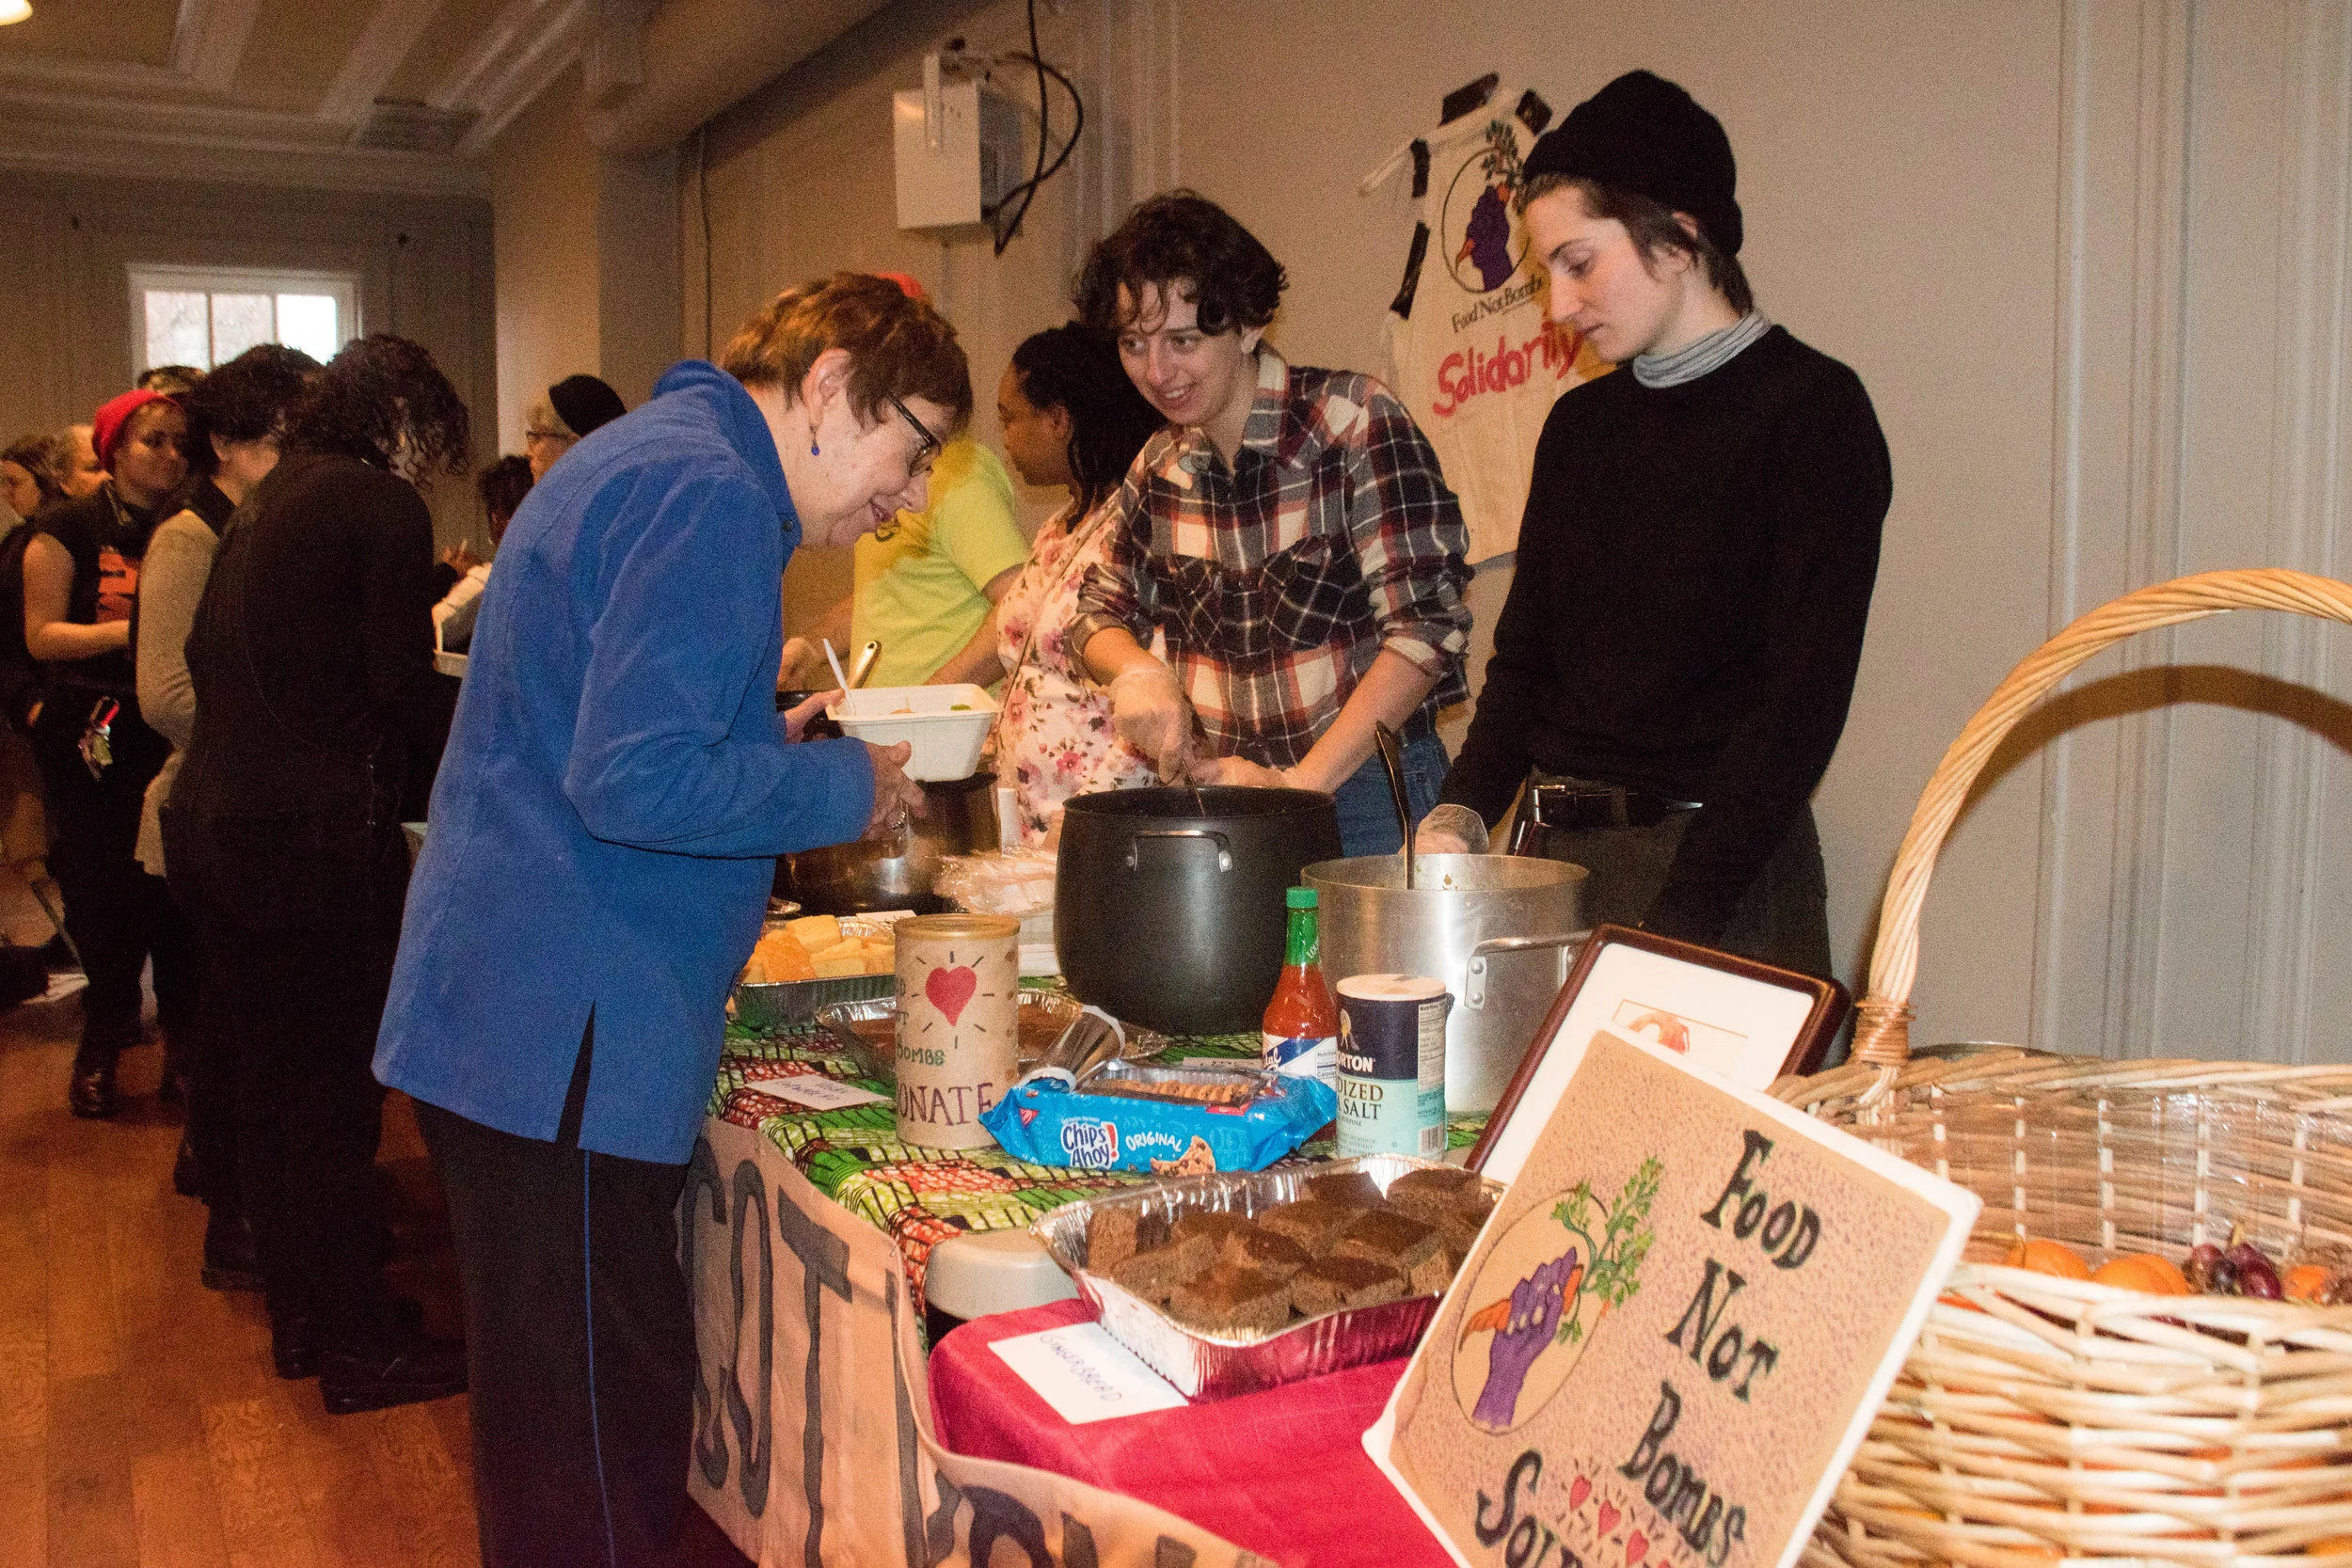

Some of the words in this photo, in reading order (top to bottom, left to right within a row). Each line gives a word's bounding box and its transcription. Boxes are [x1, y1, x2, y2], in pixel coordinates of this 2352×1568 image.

[1452, 300, 1478, 333] Food
[1478, 293, 1505, 316] Not
[1337, 1051, 1374, 1073] ORTON
[898, 1082, 993, 1127] ONATE
[1337, 1076, 1384, 1102] DIZED
[1343, 1099, 1382, 1120] SALT
[1062, 1122, 1107, 1150] Chips
[1125, 1131, 1183, 1152] ORIGINAL
[1700, 1129, 1821, 1271] FOOD
[1663, 1257, 1779, 1403] NOT
[1617, 1379, 1747, 1568] BOMBS
